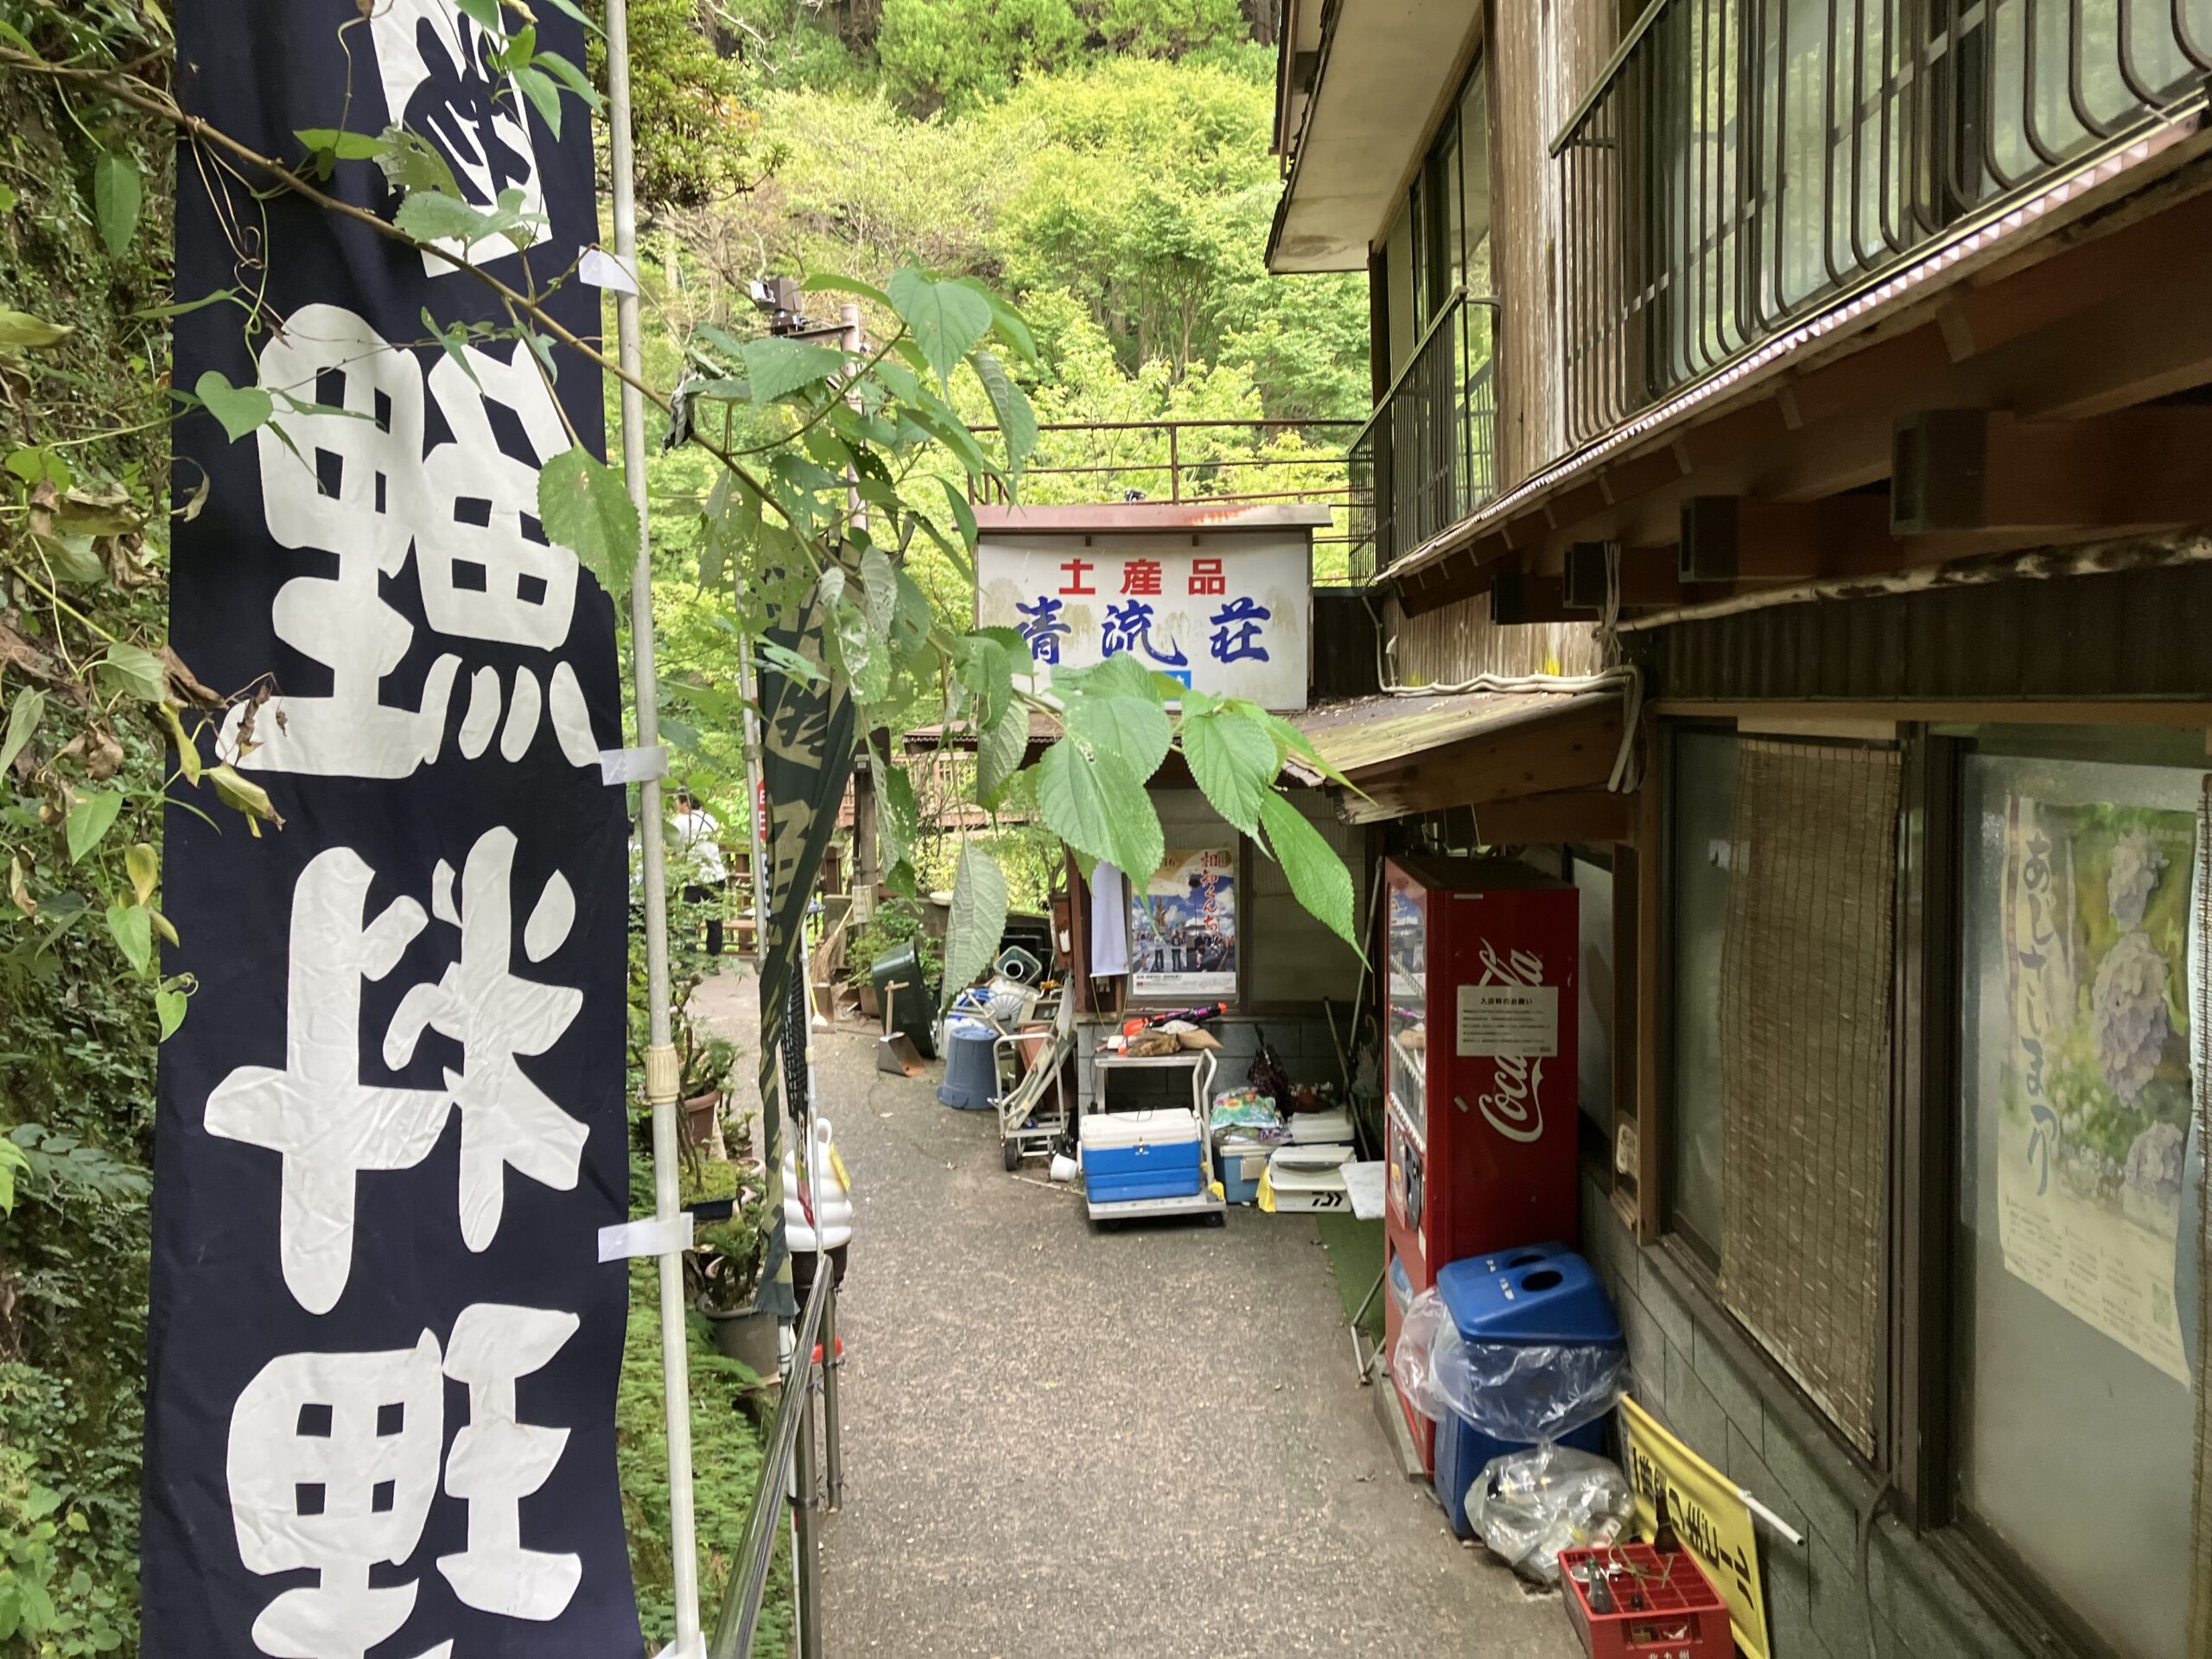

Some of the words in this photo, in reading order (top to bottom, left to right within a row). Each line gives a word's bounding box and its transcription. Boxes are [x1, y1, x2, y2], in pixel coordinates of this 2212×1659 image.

[1058, 558, 1226, 595] 土産品
[1014, 595, 1271, 666] 清流荘
[2018, 831, 2058, 1197] あじさいまつり
